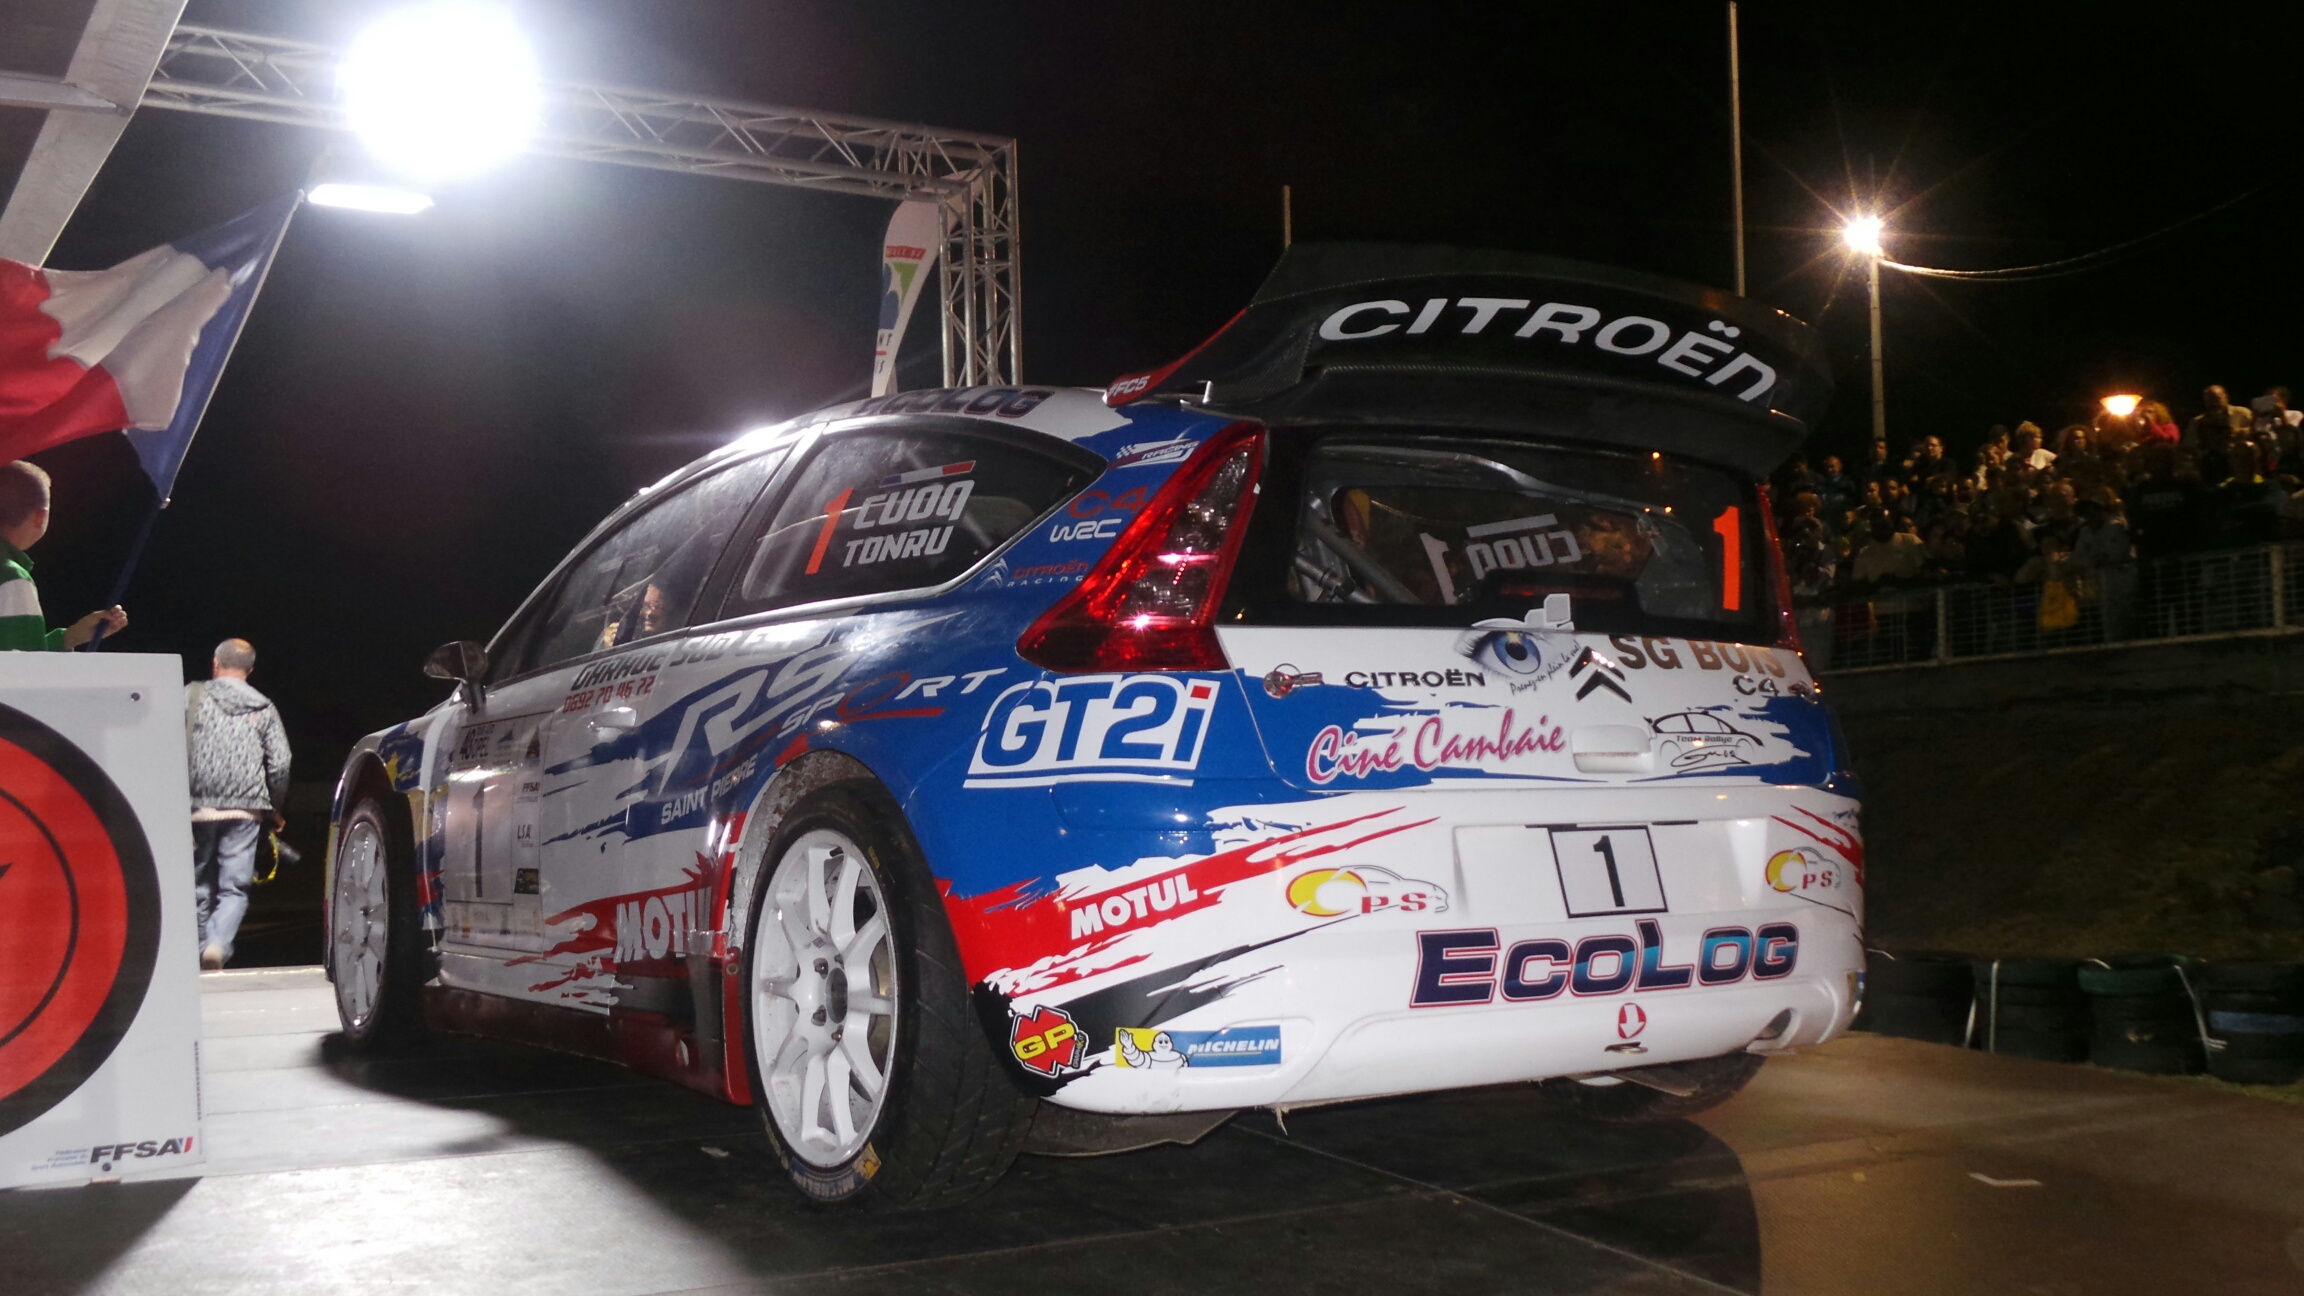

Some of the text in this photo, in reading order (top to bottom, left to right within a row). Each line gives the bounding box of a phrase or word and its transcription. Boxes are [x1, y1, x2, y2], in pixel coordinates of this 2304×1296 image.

[1106, 376, 1150, 397] #FC5
[853, 480, 975, 529] CUOQ
[1067, 486, 1149, 518] C4
[805, 486, 854, 575] 1
[843, 526, 954, 568] TONRU
[1049, 518, 1123, 543] WRC
[1713, 506, 1741, 611] 1
[1007, 575, 1084, 587] RACING
[1344, 668, 1486, 689] CITROËN
[1609, 635, 1785, 679] SG BOIS
[563, 675, 656, 714] 0692 70 46 72
[1732, 675, 1779, 697] C4
[970, 675, 1219, 767] GT2i
[1307, 708, 1566, 782] Ciné Cambaie
[661, 752, 759, 825] SAINT PIERRE
[472, 780, 485, 898] 1
[1592, 835, 1625, 908] 1
[1070, 873, 1199, 941] MOTUL
[1014, 1022, 1075, 1060] GP
[1186, 1038, 1280, 1056] MICHELIN
